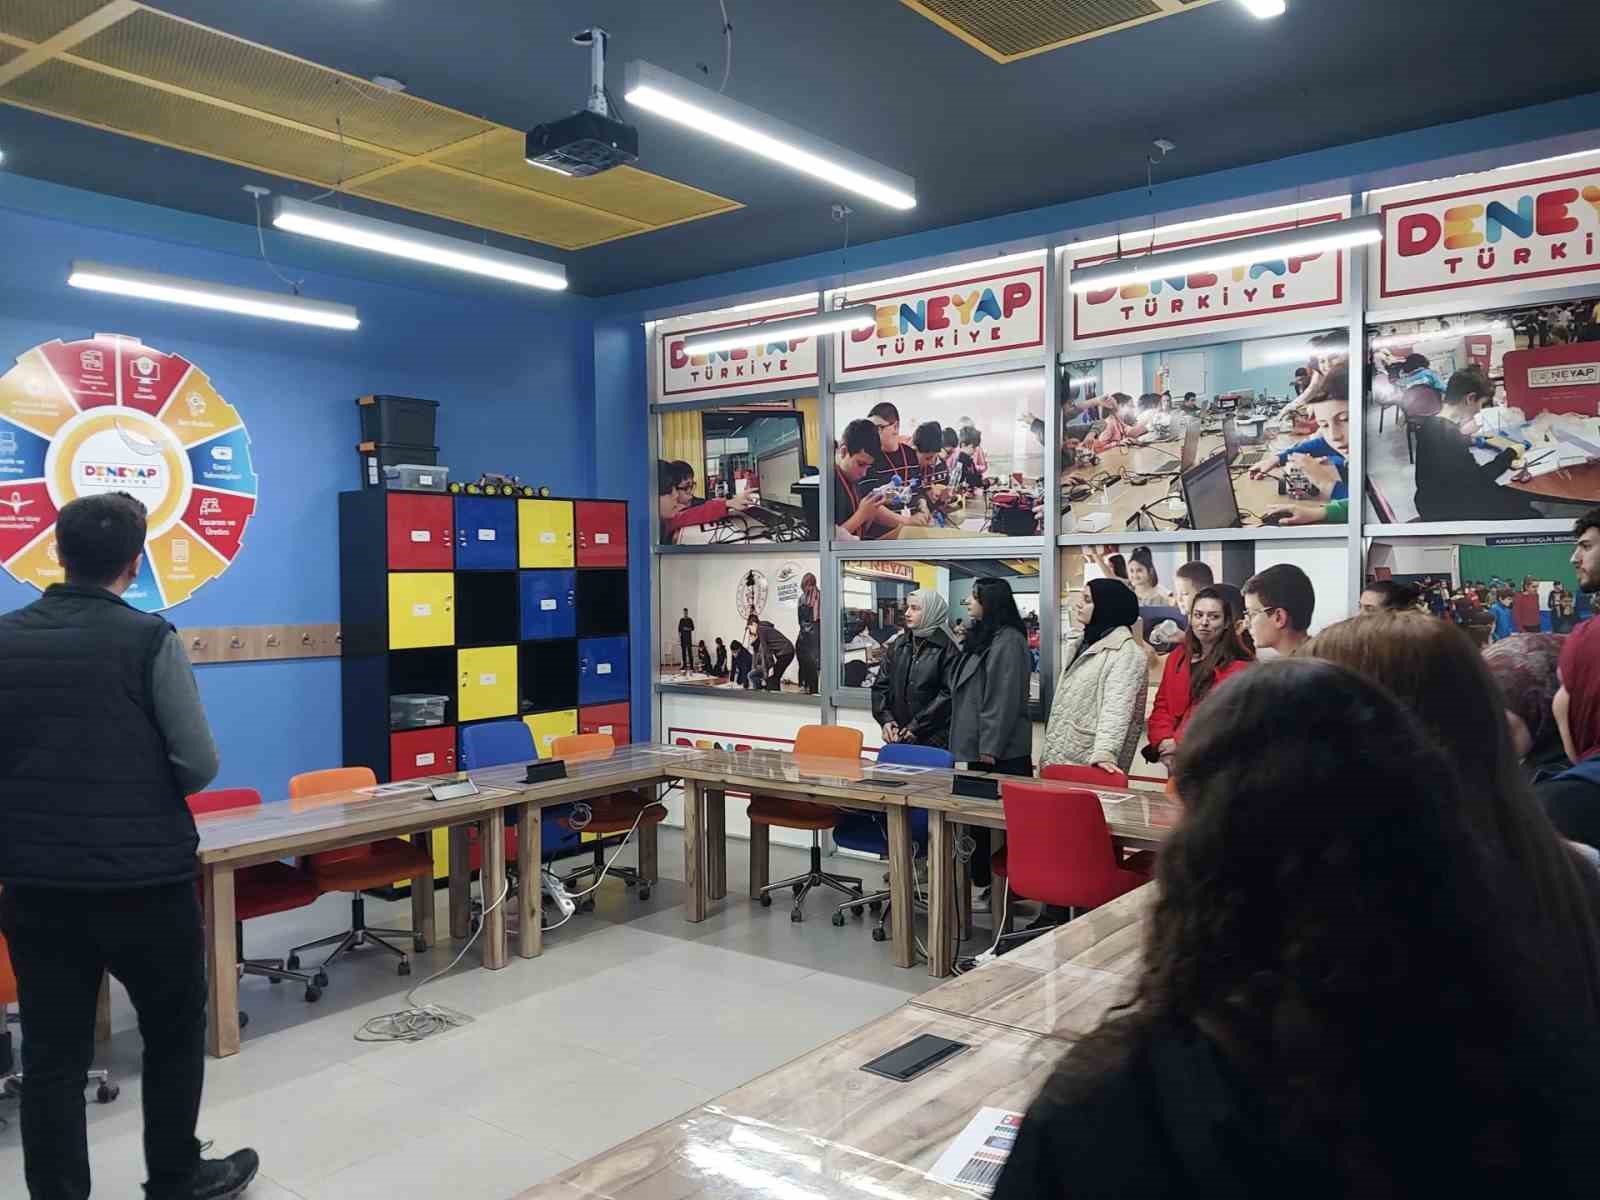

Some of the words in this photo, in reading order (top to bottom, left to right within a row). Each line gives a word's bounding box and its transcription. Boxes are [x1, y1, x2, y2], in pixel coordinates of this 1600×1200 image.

[1120, 283, 1286, 320] TÜRKİYE
[876, 327, 1000, 356] TÜRKİYE
[690, 359, 788, 383] TÜRKİYE
[85, 465, 157, 478] DENEYAP
